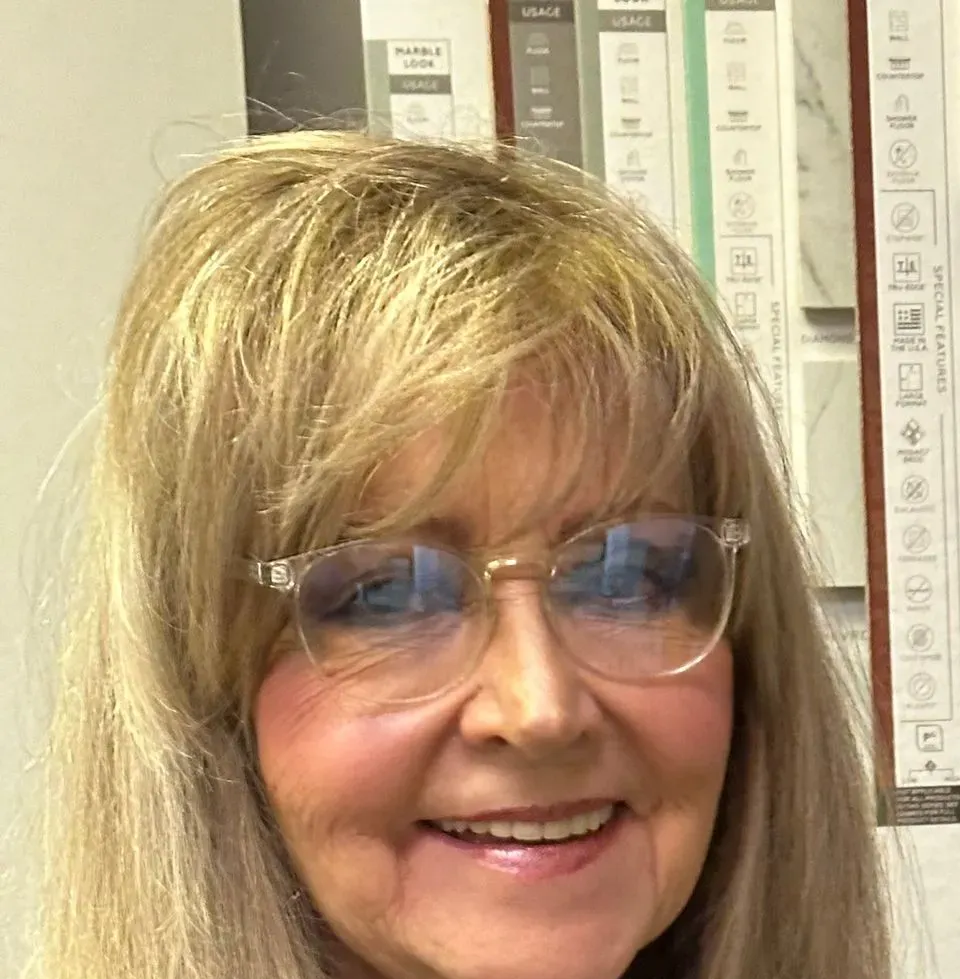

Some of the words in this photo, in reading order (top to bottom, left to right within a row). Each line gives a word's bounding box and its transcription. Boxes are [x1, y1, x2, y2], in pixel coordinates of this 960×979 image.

[521, 6, 561, 18] USAGE
[612, 16, 651, 27] USAGE
[395, 46, 441, 57] MARBLE
[403, 58, 435, 69] LOOK
[402, 79, 438, 91] USAGE
[933, 265, 945, 322] SPECIAL
[771, 301, 781, 350] SPECIAL
[935, 325, 947, 394] FEATURES
